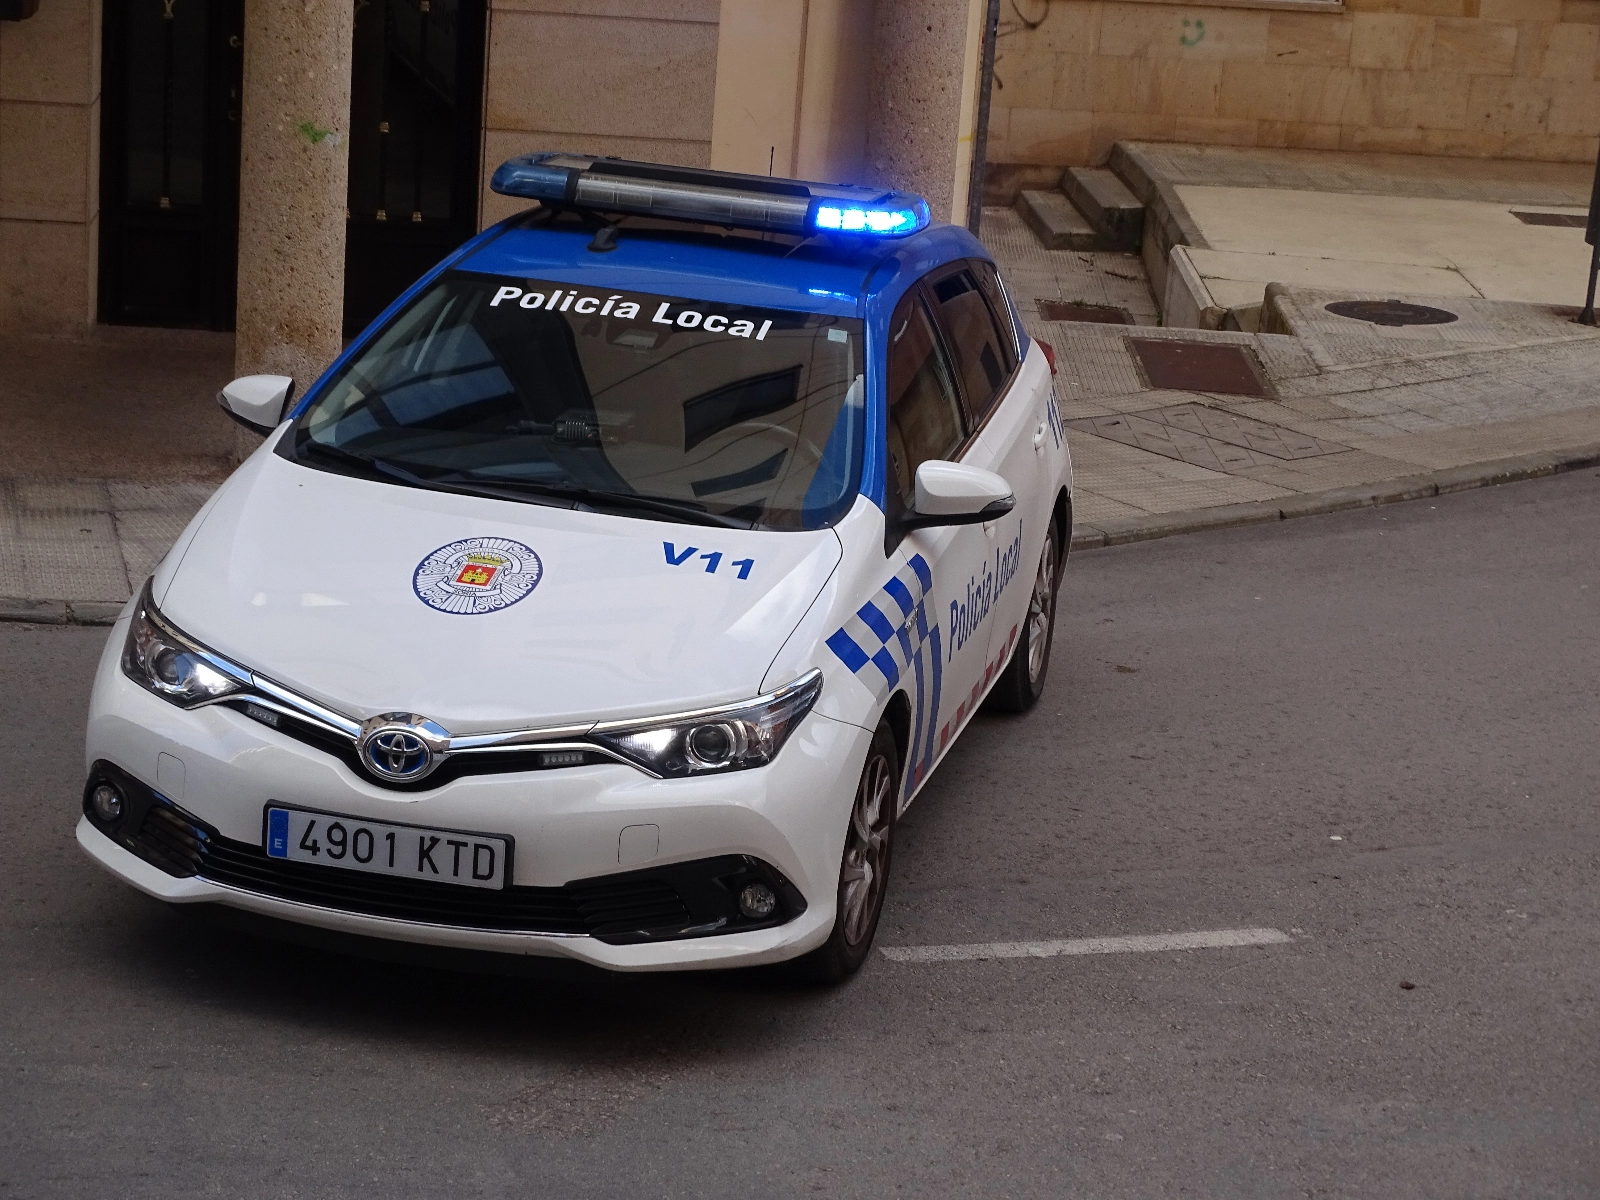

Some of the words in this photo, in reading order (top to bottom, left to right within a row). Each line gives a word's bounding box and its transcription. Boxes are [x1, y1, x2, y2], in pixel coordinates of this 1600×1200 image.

[490, 286, 642, 320] Policía
[652, 302, 773, 341] Local
[662, 541, 755, 580] V11
[948, 560, 993, 663] Policía
[992, 518, 1023, 604] Local
[274, 838, 283, 849] E
[299, 819, 396, 868] 4901
[417, 835, 495, 881] KTD
